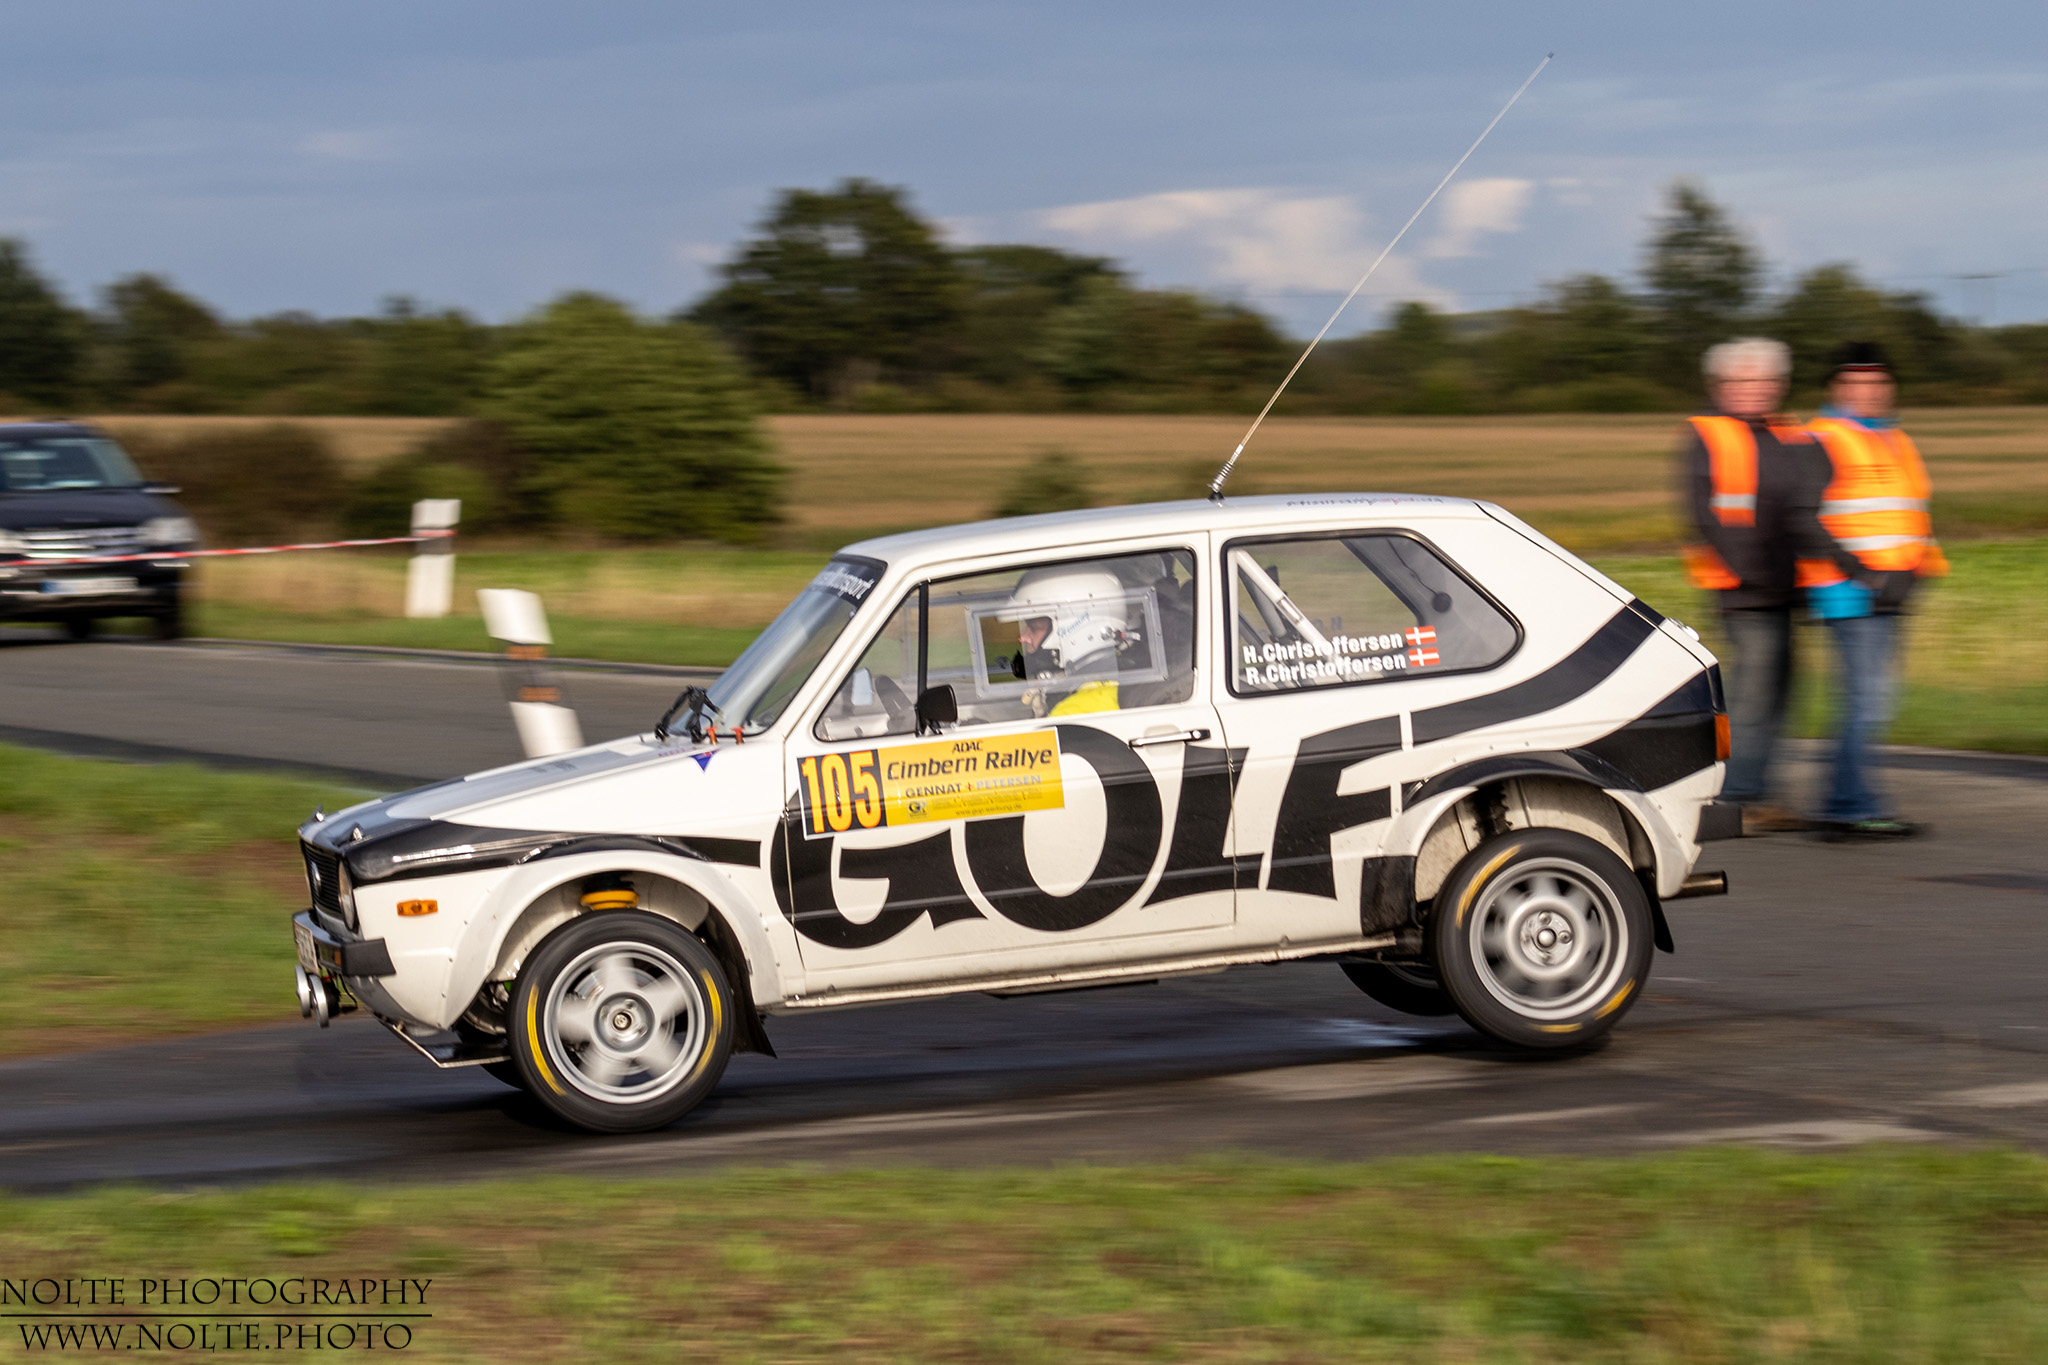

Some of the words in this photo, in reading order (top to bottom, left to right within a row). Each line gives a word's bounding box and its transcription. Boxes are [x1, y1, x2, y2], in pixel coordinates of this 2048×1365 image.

[1243, 632, 1404, 665] H.Christoffersen
[1245, 653, 1407, 686] R.Christoffersen
[952, 740, 984, 754] ADAC
[887, 756, 978, 781] Cimbern
[985, 748, 1053, 771] Rallye
[801, 749, 883, 834] 105
[905, 783, 961, 799] GENNAT
[976, 774, 1042, 791] PETERSEN
[770, 714, 1404, 950] GOLF
